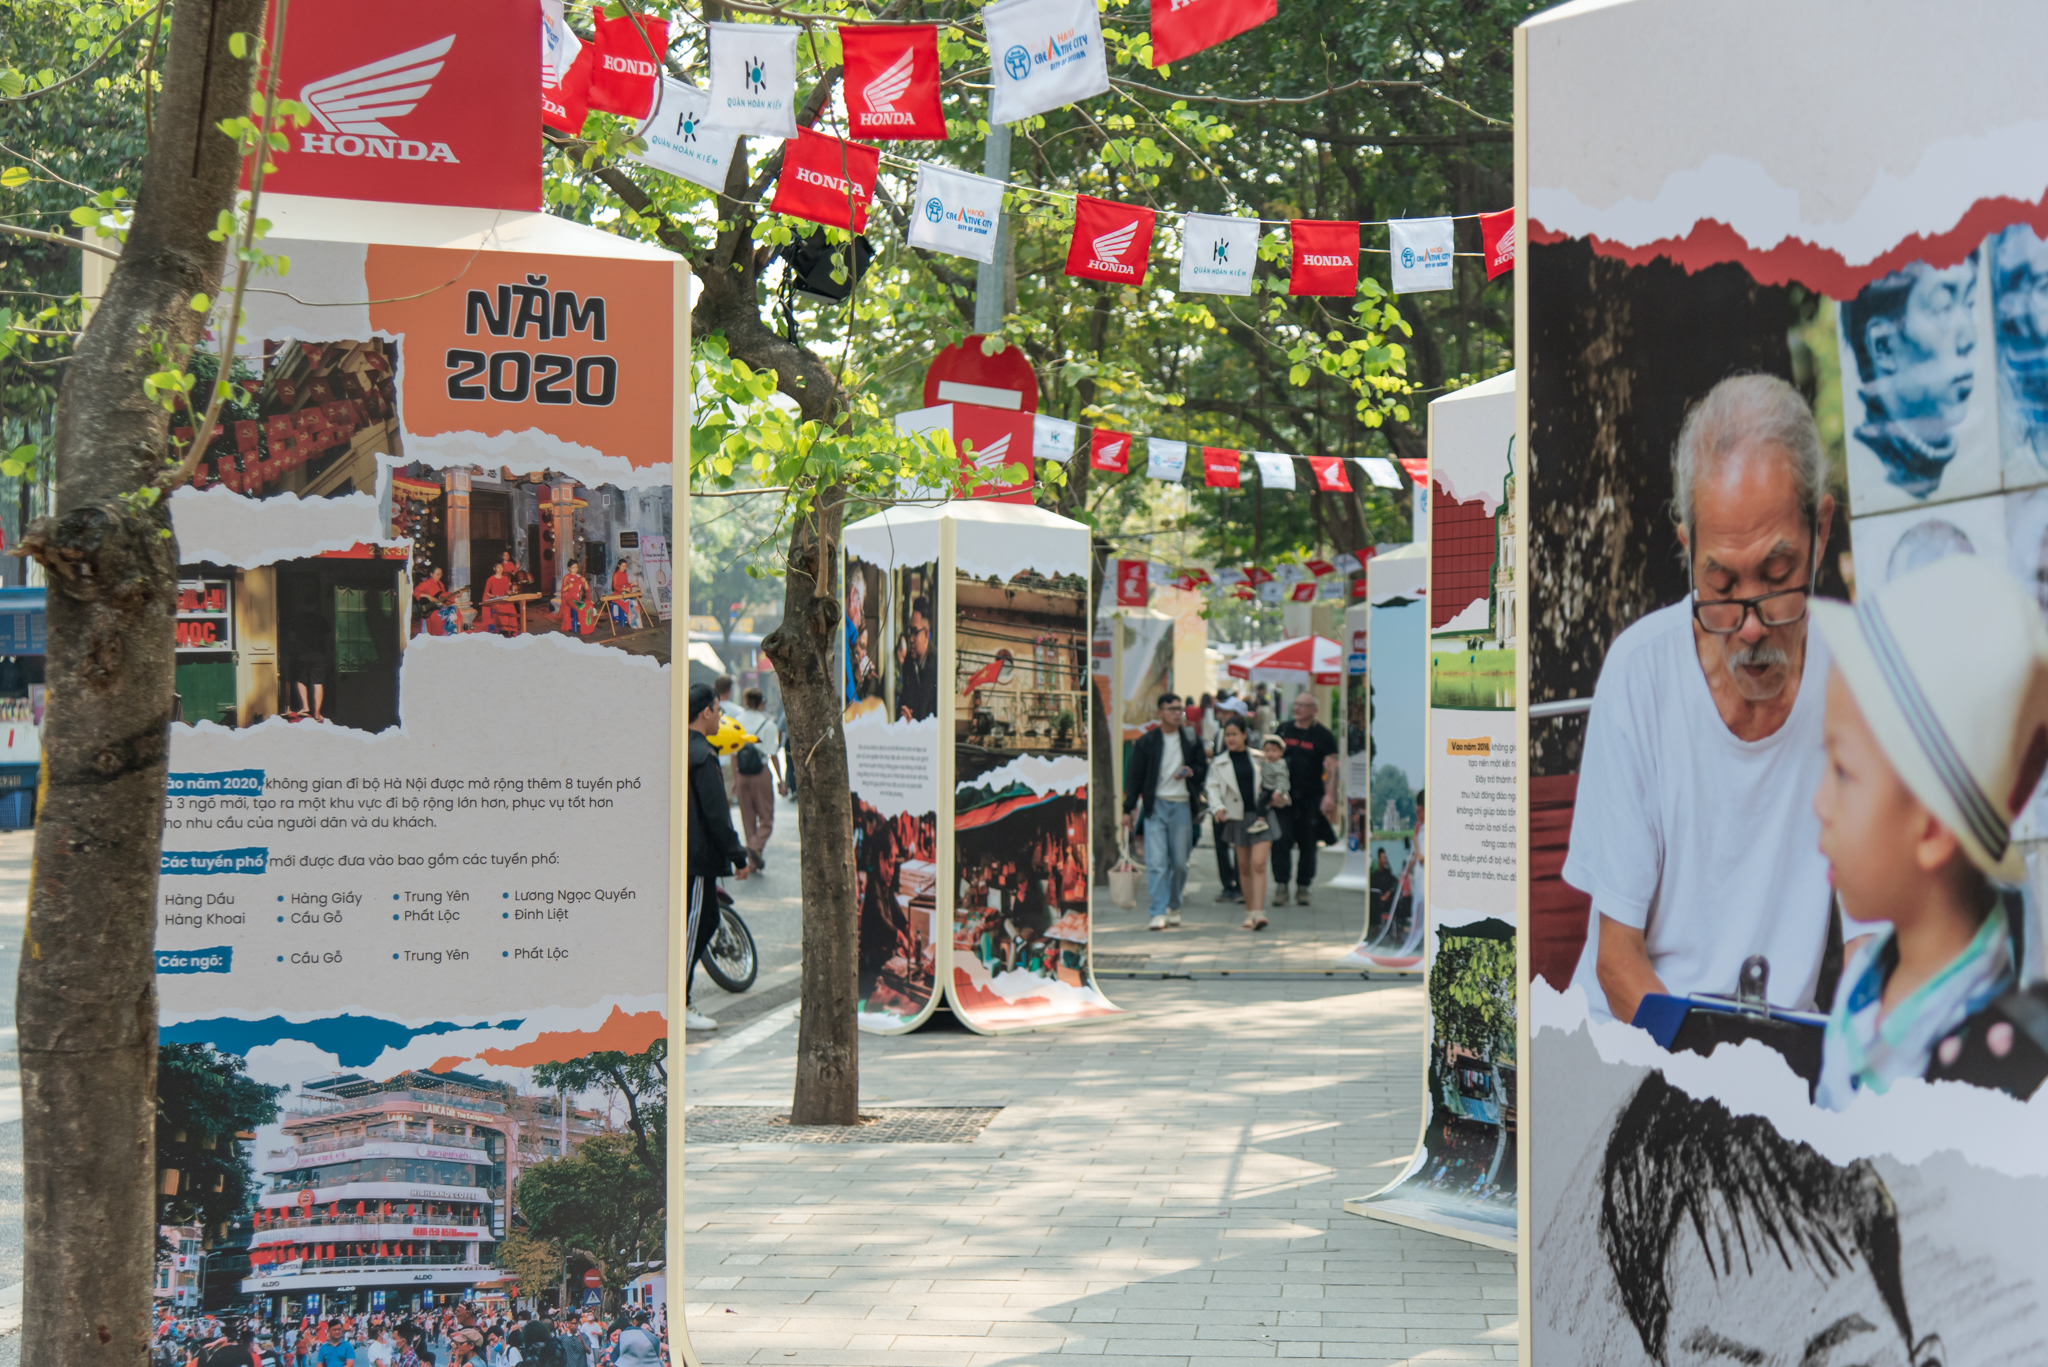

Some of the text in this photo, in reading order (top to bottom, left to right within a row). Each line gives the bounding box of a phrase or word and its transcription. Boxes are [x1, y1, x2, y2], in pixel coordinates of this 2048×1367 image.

[860, 112, 916, 126] HONDA
[301, 132, 460, 163] HONDA
[652, 135, 718, 166] QUẬN HOÀN KIẾM
[982, 219, 993, 229] CITY
[1087, 259, 1134, 274] HONDA
[1303, 254, 1353, 266] HONDA
[1194, 266, 1211, 275] QUẬN
[1230, 269, 1247, 277] KIẾM
[465, 273, 606, 342] NĂM
[445, 348, 618, 407] 2020
[1452, 742, 1464, 751] Vào
[1478, 743, 1491, 752] 2016,
[1492, 743, 1509, 754] không
[1469, 760, 1478, 769] tạo
[1479, 759, 1489, 767] nên
[1490, 759, 1501, 769] một
[167, 777, 641, 793] ào năm 2020, không gian đi bộ Hà Nội được mở rộng thêm 8 tuyến phố
[1496, 775, 1512, 784] thành
[177, 796, 614, 812] 3 ngõ mới, tạo ra một khu vực đi bộ rộng lớn hơn, phục vụ tốt hơn
[1457, 806, 1473, 817] không
[186, 818, 212, 828] nhu
[247, 816, 273, 828] của
[278, 816, 316, 831] người
[321, 817, 347, 828] dân
[351, 817, 368, 828] và
[372, 817, 389, 828] du
[393, 817, 437, 828] khách.
[1465, 822, 1475, 831] mà
[1486, 823, 1492, 832] là
[161, 857, 188, 868] Các
[191, 854, 233, 871] tuyến
[236, 854, 264, 871] phố
[269, 855, 296, 867] mới
[299, 855, 334, 869] được
[338, 855, 365, 866] đưa
[369, 855, 394, 866] vào
[398, 855, 424, 866] bao
[463, 853, 488, 865] các
[491, 852, 527, 868] tuyến
[532, 852, 560, 868] phố:
[165, 894, 203, 909] Hàng
[291, 892, 328, 908] Hàng
[404, 890, 470, 905] Trung Yên
[515, 887, 636, 904] Lương Ngọc Quyến
[165, 913, 246, 928] Hàng Khoai
[324, 910, 343, 924] Gỗ
[404, 909, 460, 924] Phất Lộc
[515, 908, 569, 922] Đinh Liệt
[323, 950, 343, 964] Gỗ
[404, 949, 470, 965] Trung Yên
[515, 946, 569, 961] Phất Lộc
[159, 955, 223, 970] Các ngõ:
